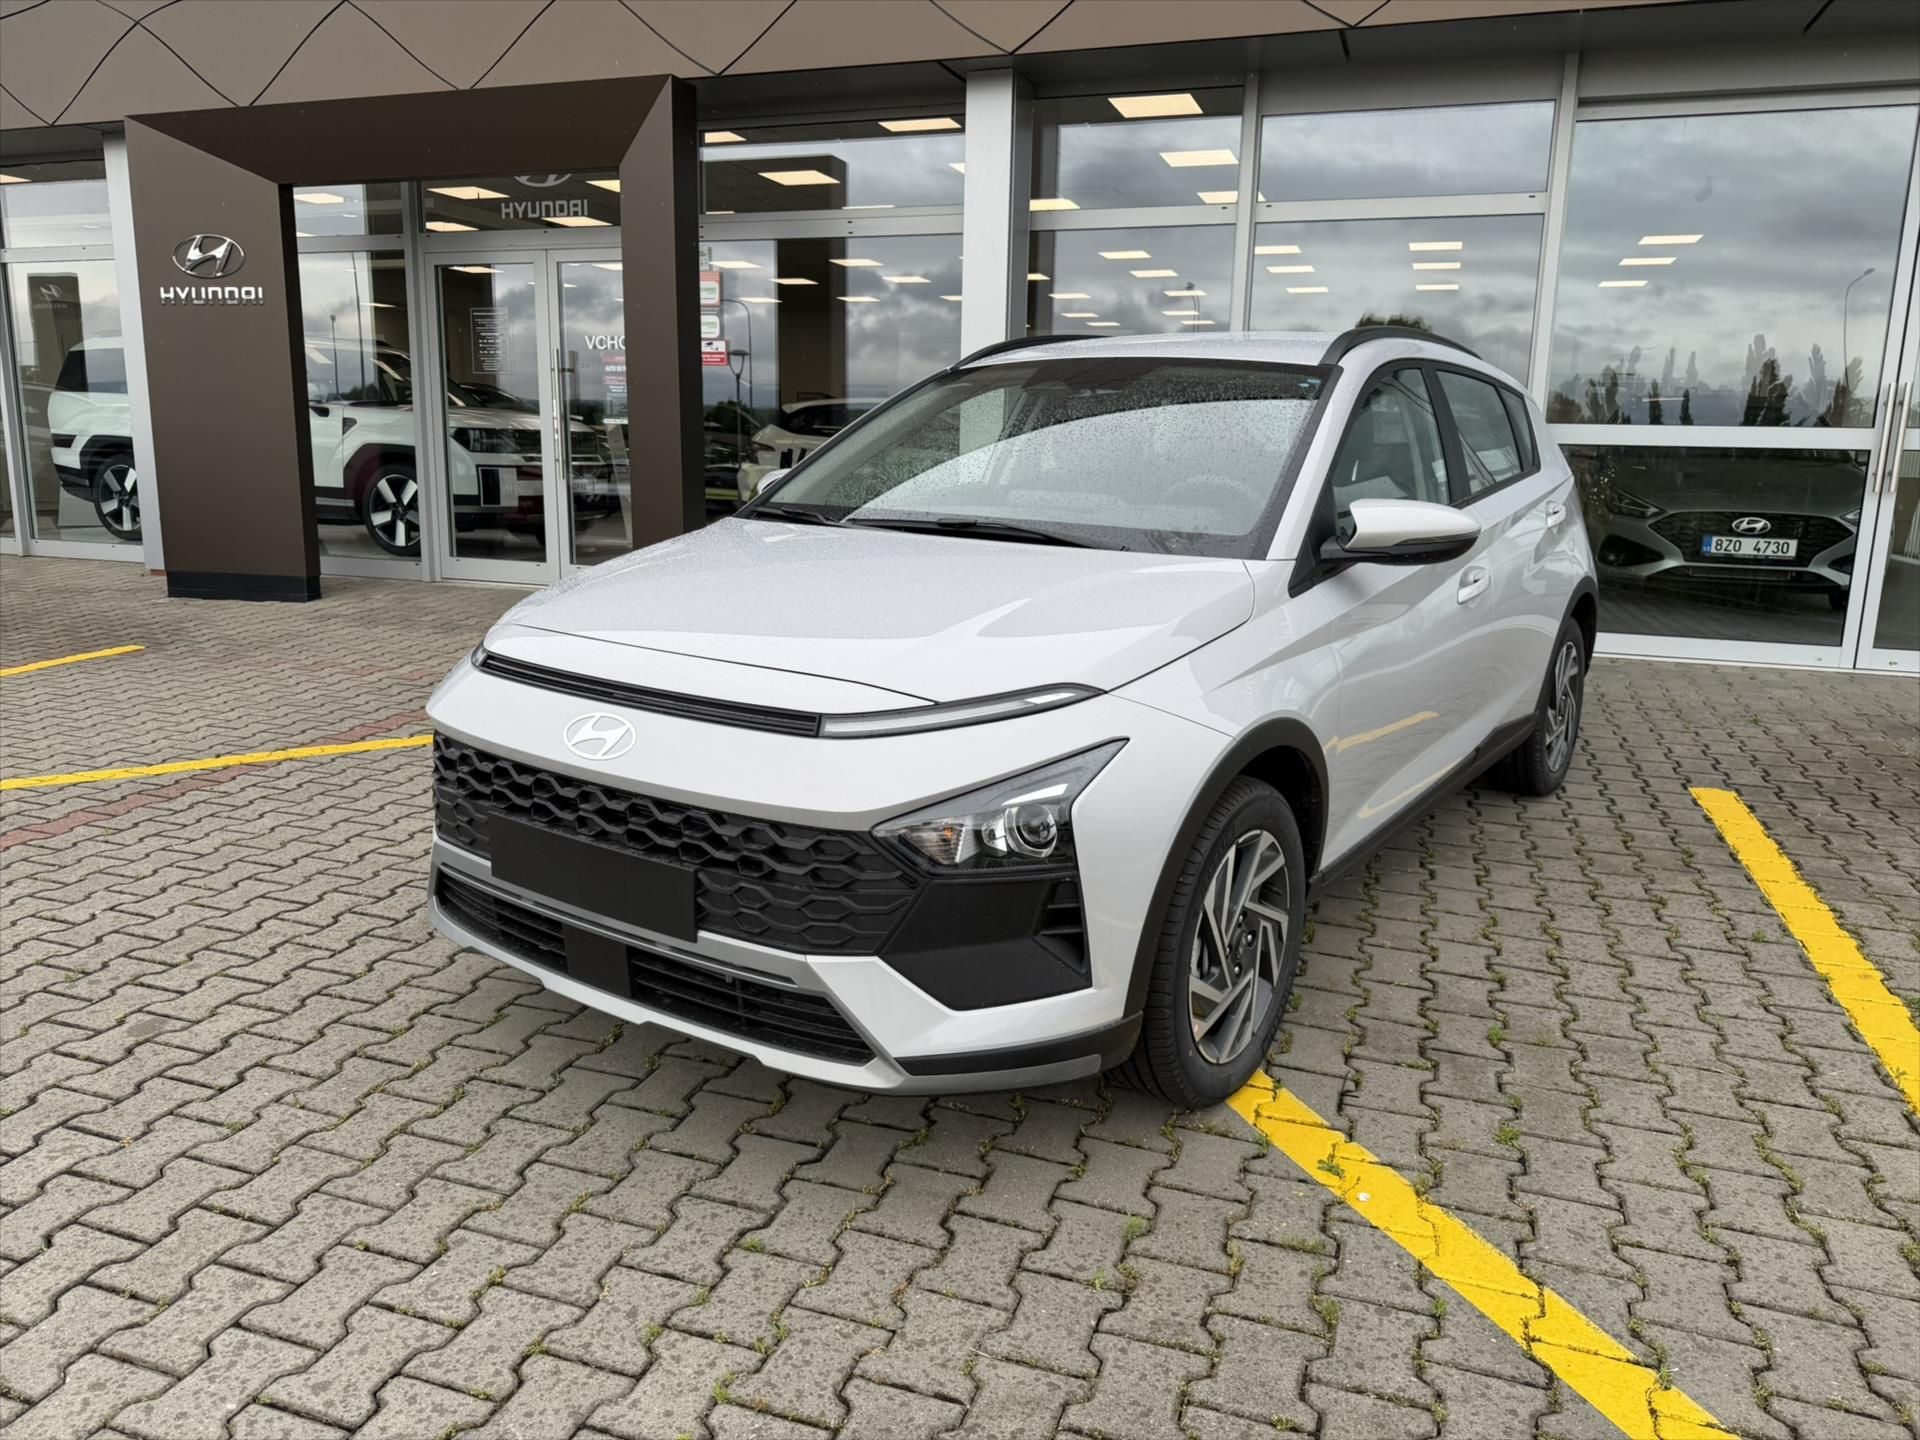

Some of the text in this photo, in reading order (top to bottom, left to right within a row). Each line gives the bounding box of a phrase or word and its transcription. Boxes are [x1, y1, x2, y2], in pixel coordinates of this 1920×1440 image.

[500, 199, 588, 219] HYUNDAI
[160, 286, 264, 305] HYUNDAI
[1753, 540, 1790, 555] 4730
